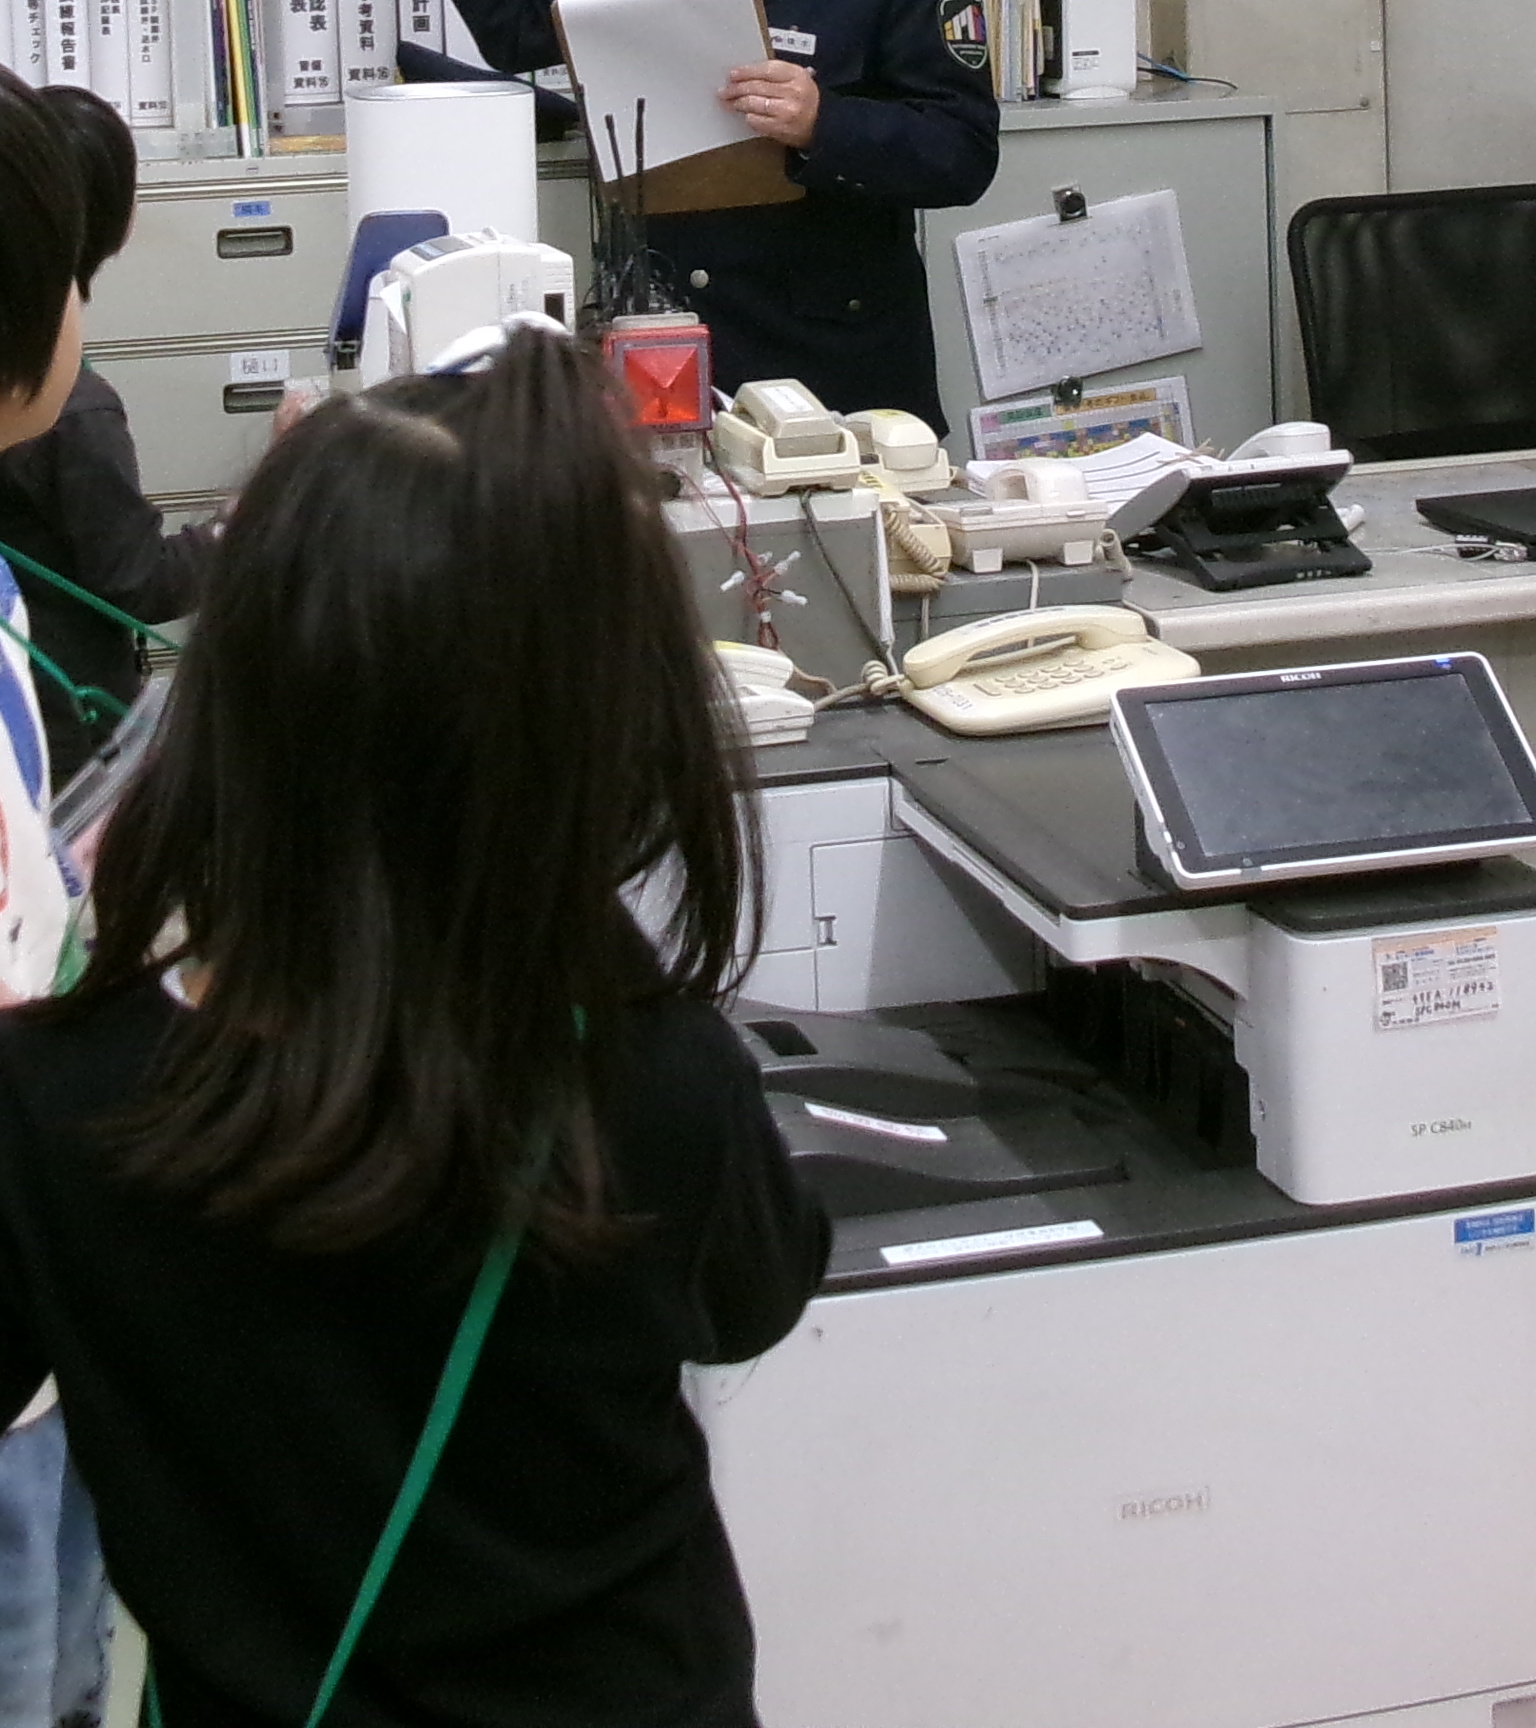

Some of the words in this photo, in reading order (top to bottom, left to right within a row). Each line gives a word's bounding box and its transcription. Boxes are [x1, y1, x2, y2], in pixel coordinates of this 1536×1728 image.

[1280, 672, 1323, 683] RICOH
[1410, 1122, 1426, 1137] SP
[1121, 1489, 1207, 1520] RICOH
